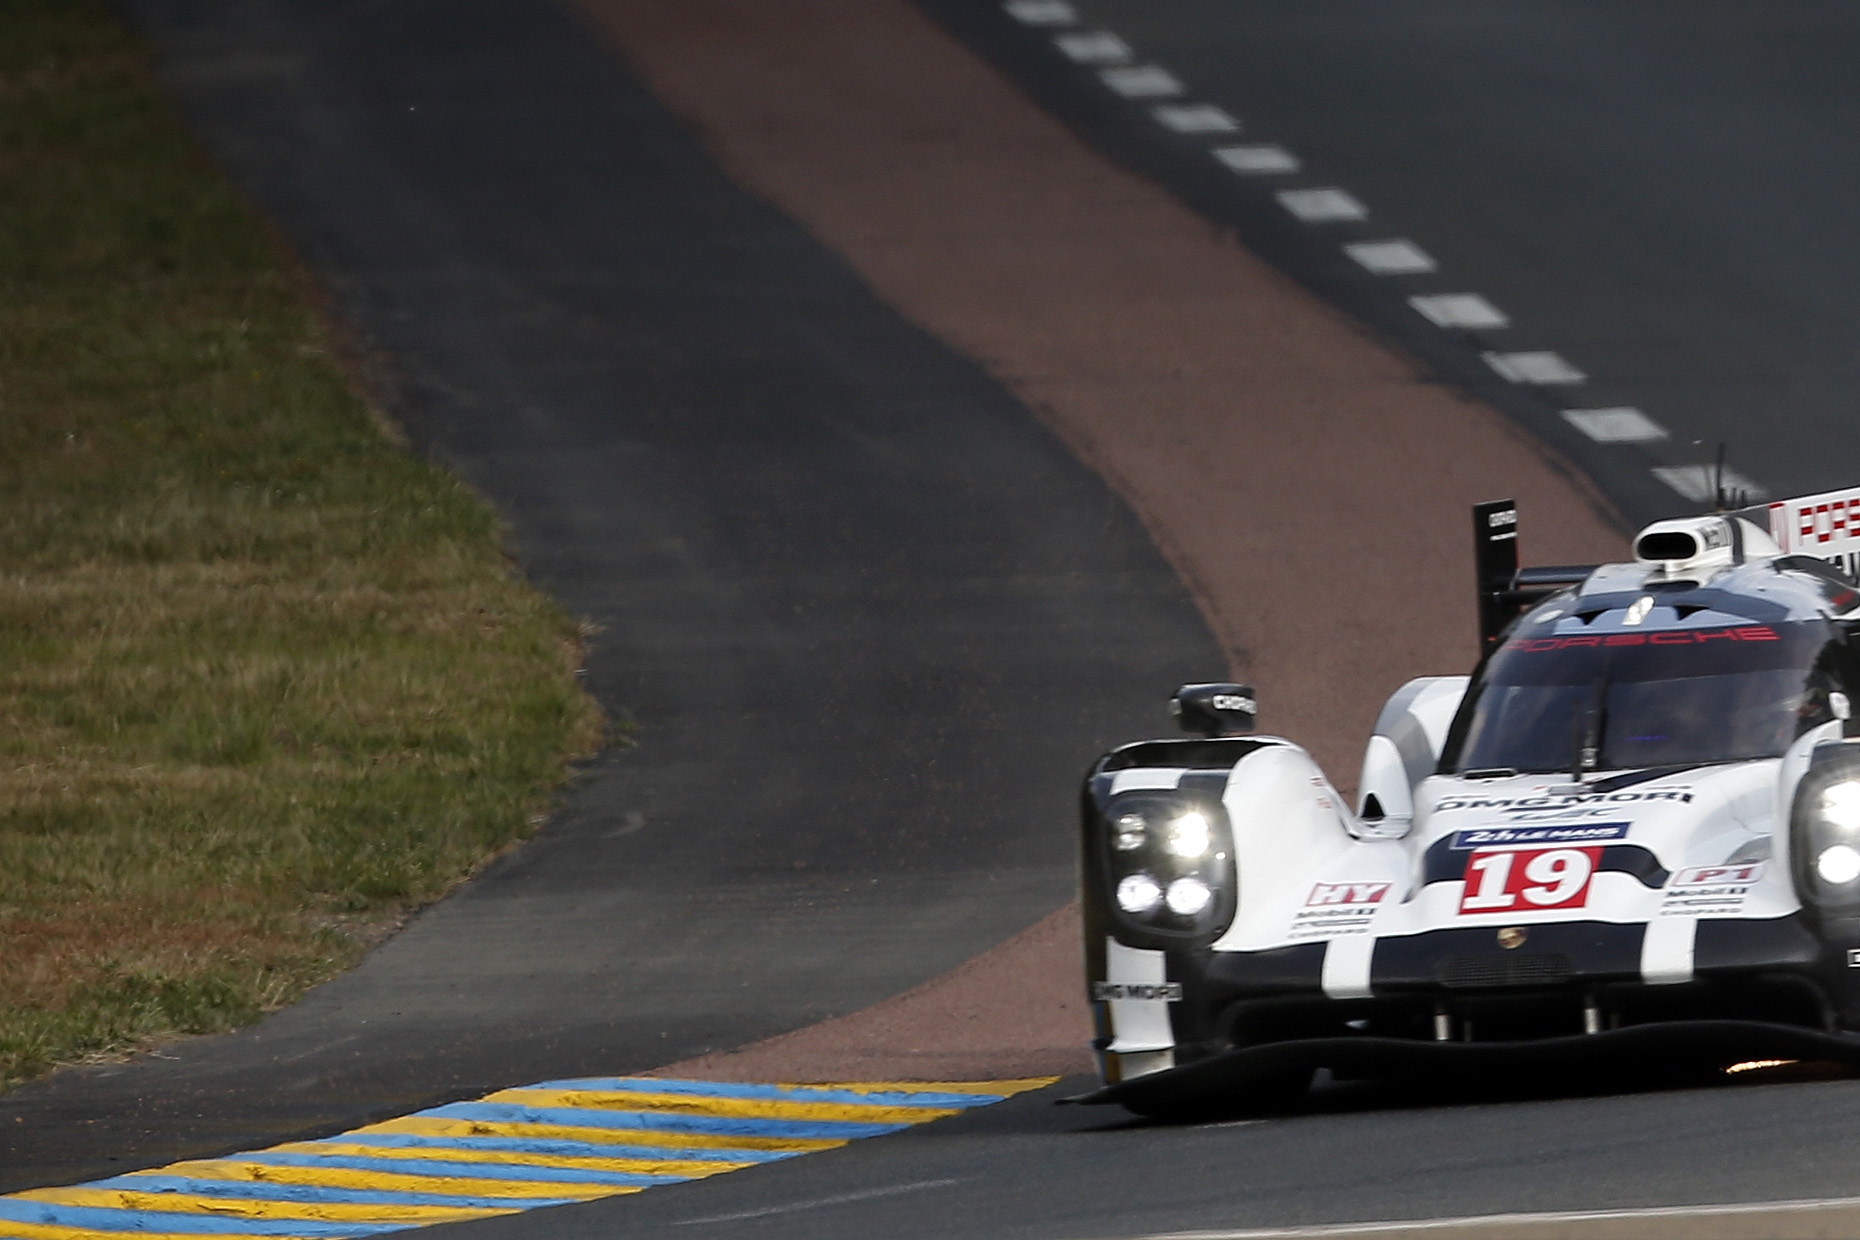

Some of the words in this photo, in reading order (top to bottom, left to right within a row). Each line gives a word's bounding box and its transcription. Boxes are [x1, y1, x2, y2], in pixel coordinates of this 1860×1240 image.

[1502, 625, 1781, 653] PORSCHE
[1437, 797, 1552, 811] DMG
[1558, 792, 1695, 804] MORI
[1548, 827, 1620, 838] MANS
[1463, 849, 1592, 910] 19
[1692, 867, 1755, 883] P1
[1307, 883, 1388, 904] HY
